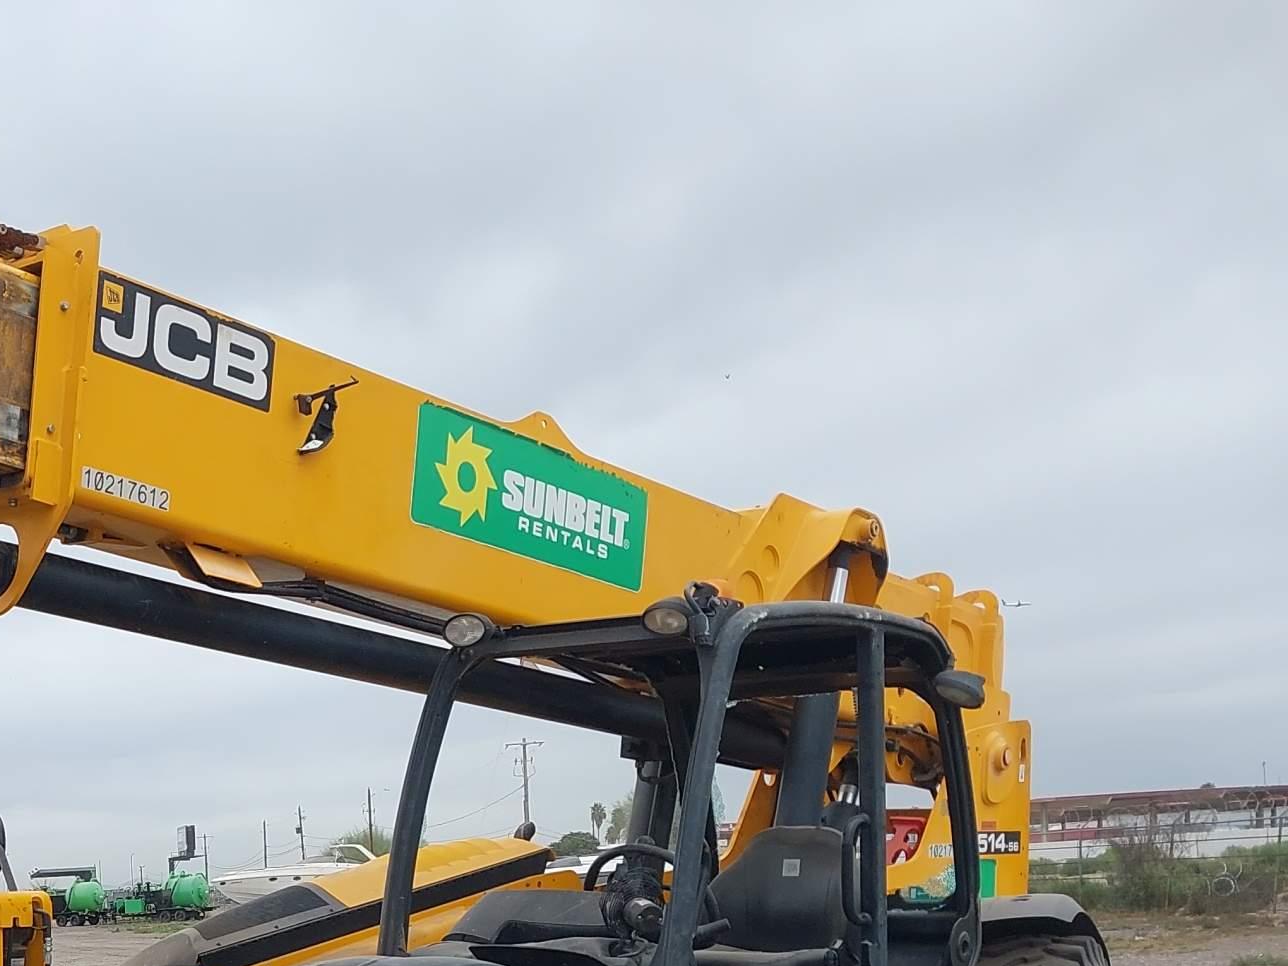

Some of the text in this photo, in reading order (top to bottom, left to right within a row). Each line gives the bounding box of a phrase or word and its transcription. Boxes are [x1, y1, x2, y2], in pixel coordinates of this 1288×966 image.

[100, 292, 269, 401] JCB
[84, 468, 169, 511] 10217612
[502, 469, 629, 547] SUNBELT
[518, 516, 609, 560] RENTALS
